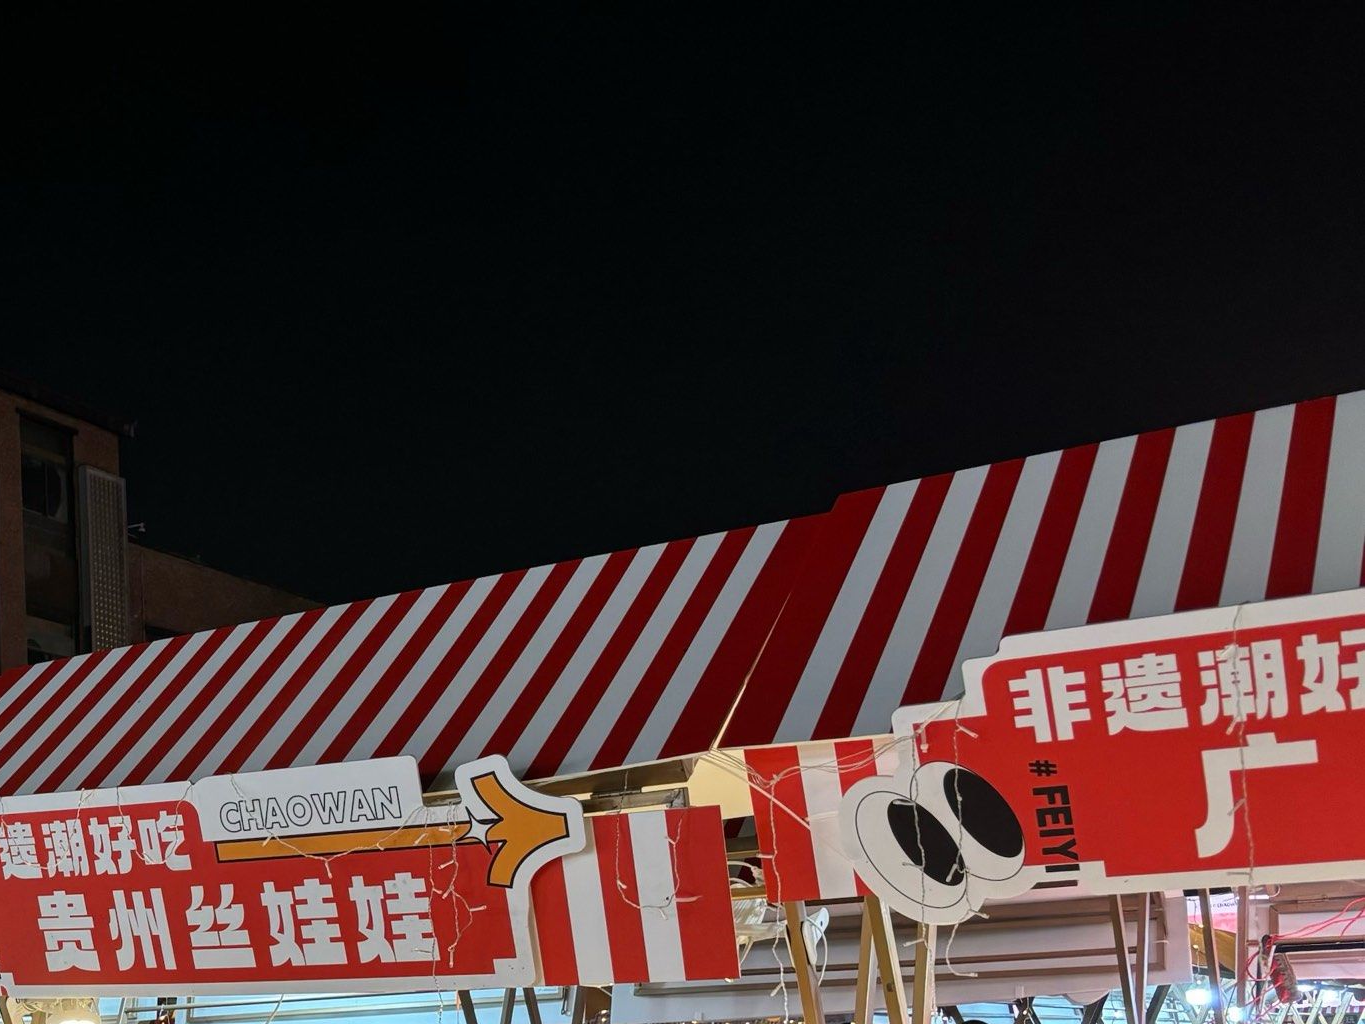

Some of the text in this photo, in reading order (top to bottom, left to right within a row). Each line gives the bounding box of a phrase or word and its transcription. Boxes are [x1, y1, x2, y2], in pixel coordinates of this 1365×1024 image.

[219, 786, 402, 834] CHAOWAN
[1194, 732, 1319, 859] 广
[34, 869, 441, 973] 贵州丝娃娃
